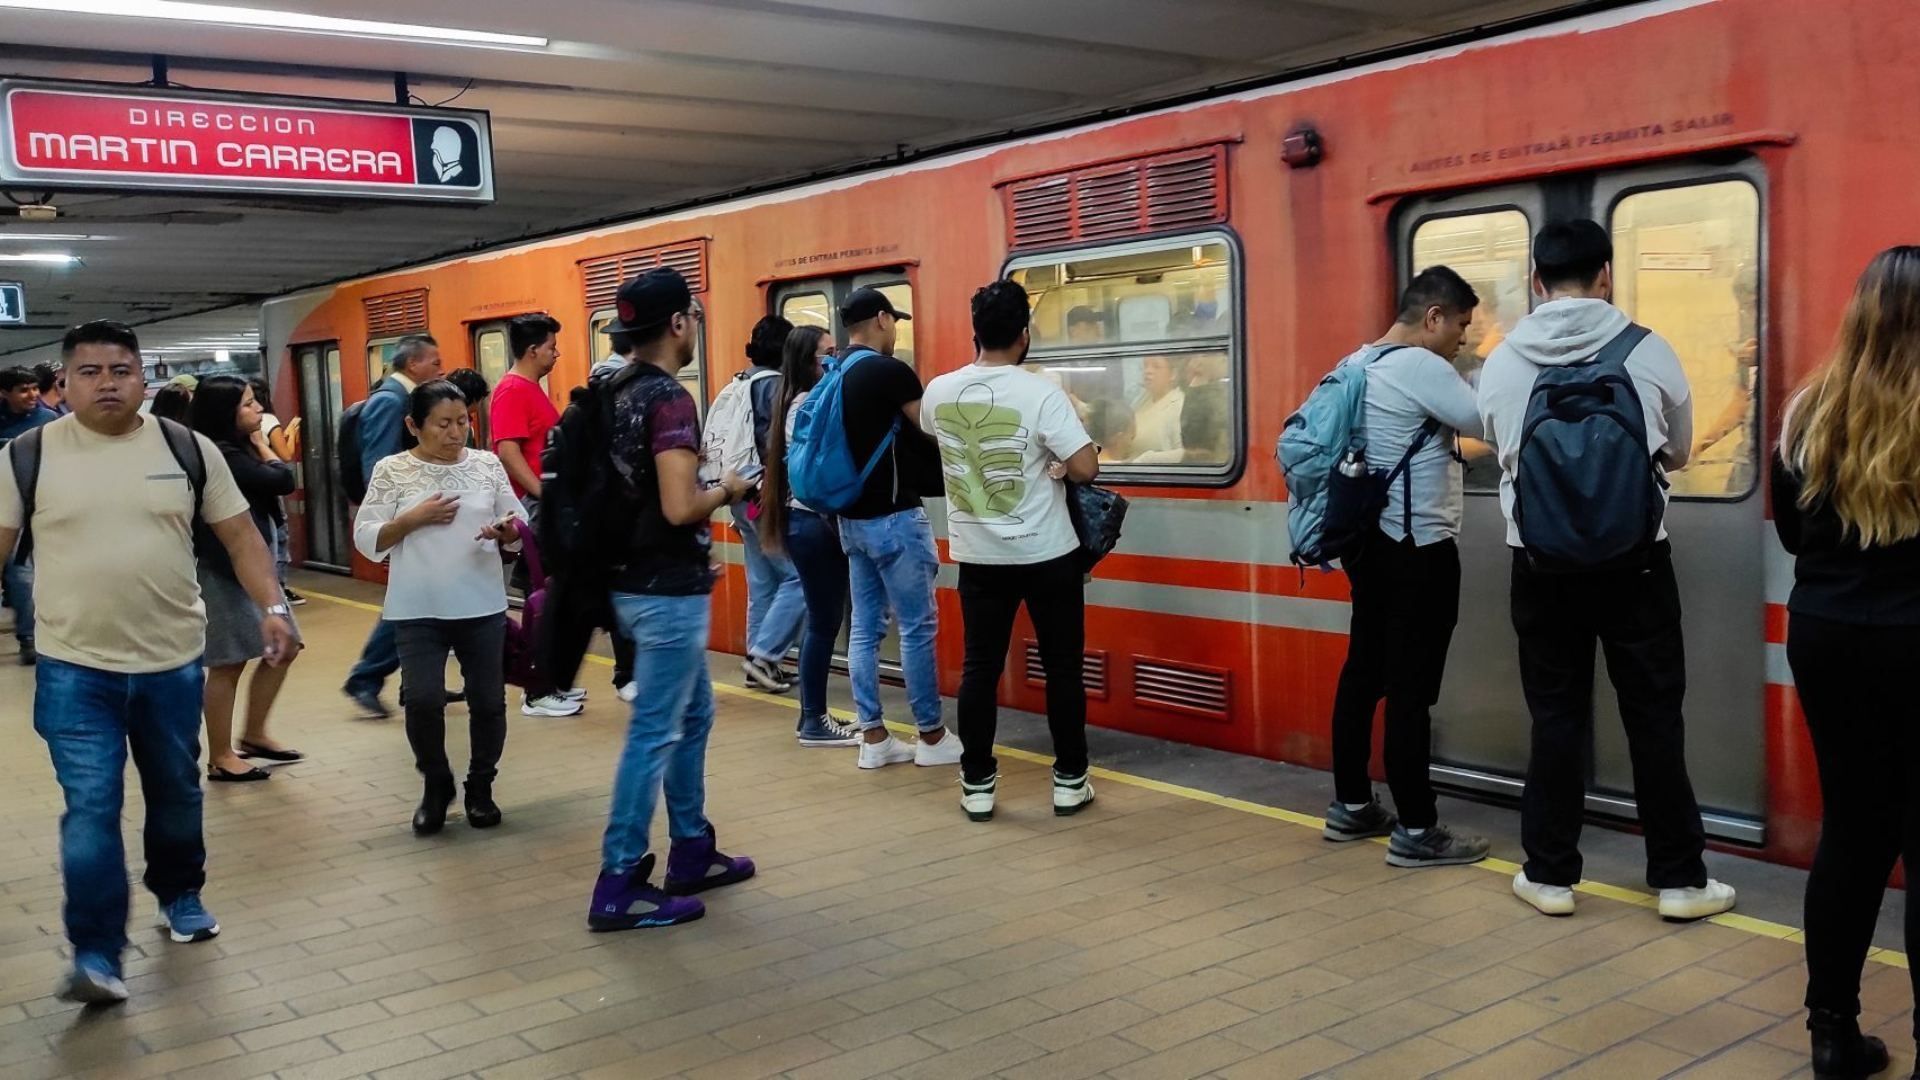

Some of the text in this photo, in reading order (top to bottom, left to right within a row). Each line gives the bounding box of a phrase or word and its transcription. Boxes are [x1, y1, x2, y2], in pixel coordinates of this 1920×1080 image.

[128, 108, 315, 135] DIRECCION
[29, 132, 403, 176] MARTIN CARRERA
